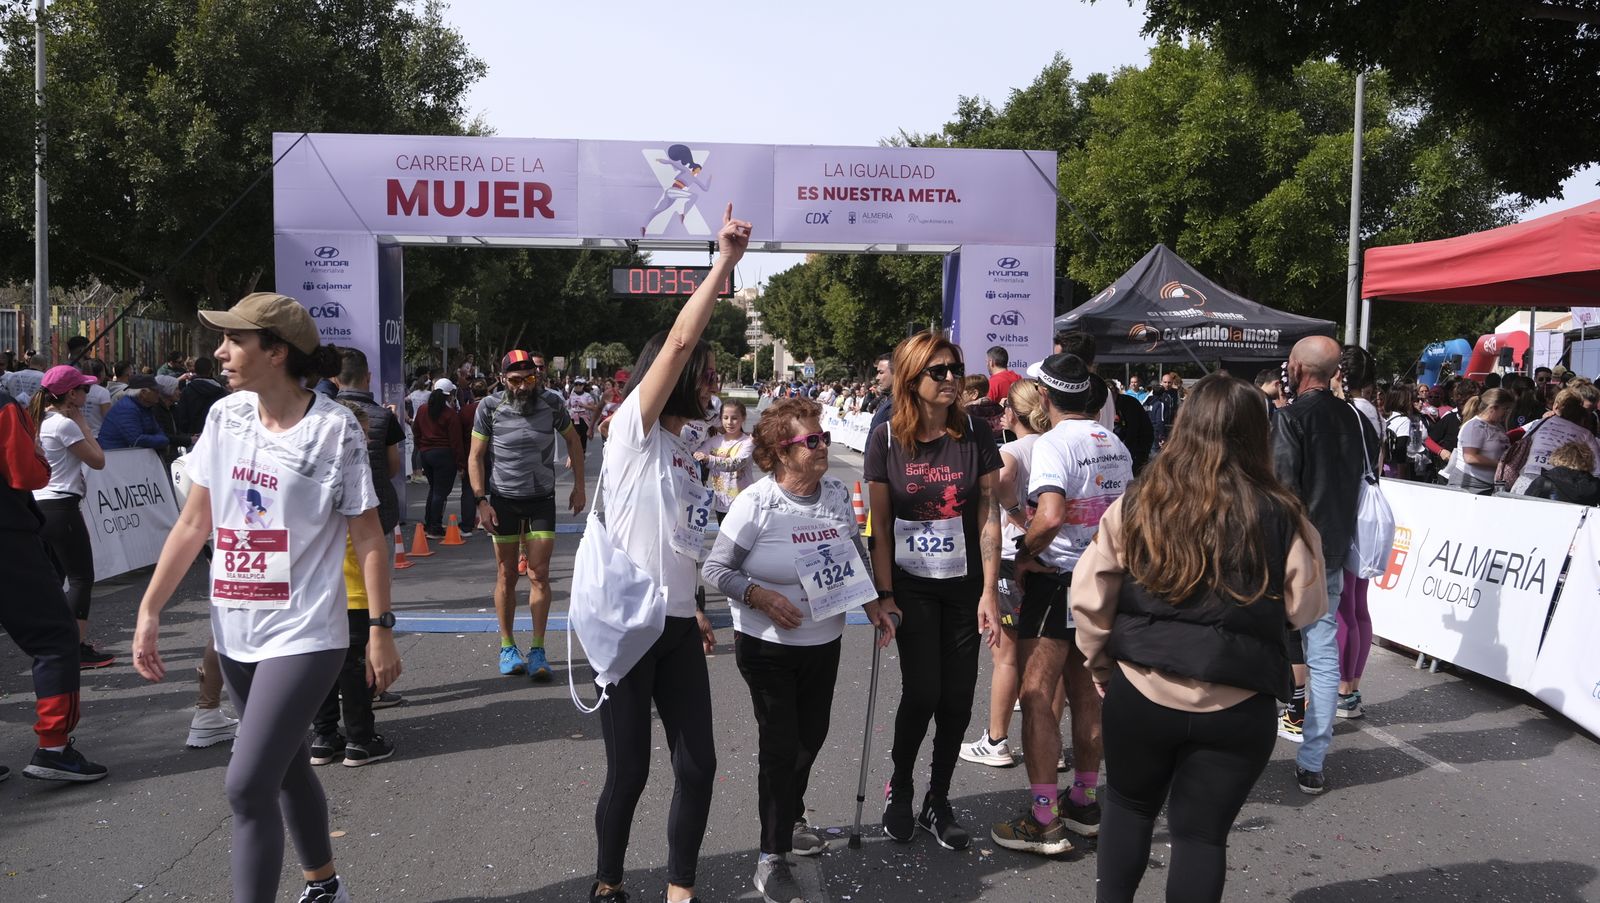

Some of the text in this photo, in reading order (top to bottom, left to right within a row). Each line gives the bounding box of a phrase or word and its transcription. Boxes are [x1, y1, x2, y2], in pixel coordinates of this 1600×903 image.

[396, 155, 545, 173] CARRERA DE LA
[824, 163, 935, 179] LA IGUALDAD
[386, 178, 555, 219] MUJER
[797, 186, 962, 204] ES NUESTRA META.
[862, 212, 893, 220] ALMERÍA
[320, 327, 351, 335] vithas
[999, 334, 1029, 342] vithas
[1163, 325, 1280, 342] cruzandolameta
[231, 465, 278, 491] MUJER
[906, 465, 950, 475] Solidaria
[928, 472, 964, 482] Mujer
[97, 477, 165, 514] ALMERÍA
[103, 514, 140, 534] CIUDAD
[791, 528, 840, 544] MUJER
[906, 536, 955, 552] 1325
[225, 552, 267, 573] 824
[1428, 540, 1546, 595] ALMERÍA
[812, 561, 855, 589] 1324
[1422, 576, 1482, 609] CIUDAD
